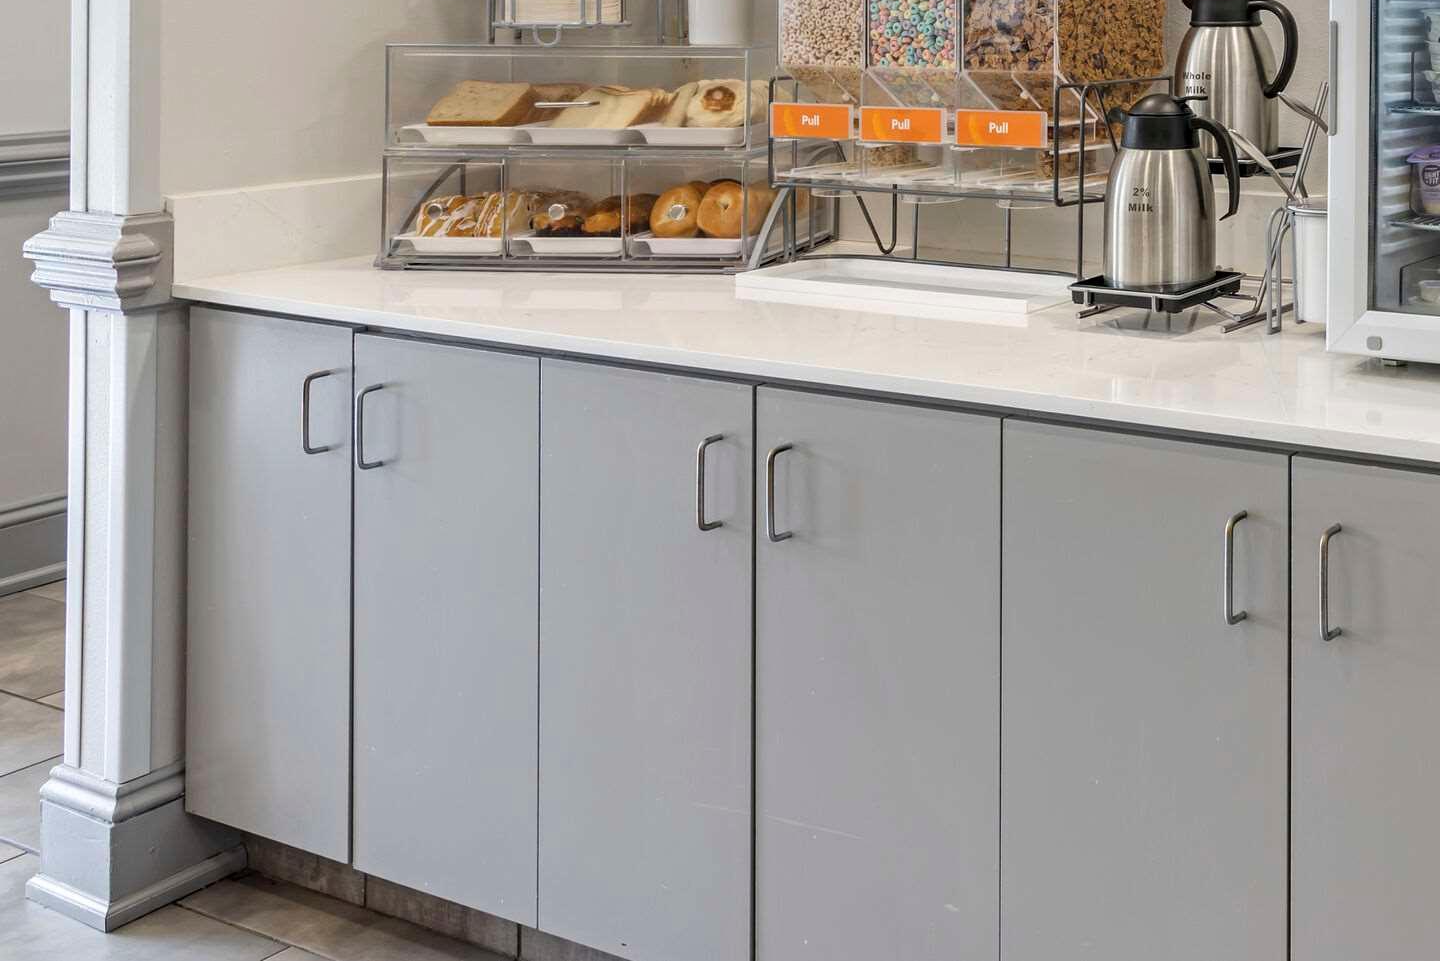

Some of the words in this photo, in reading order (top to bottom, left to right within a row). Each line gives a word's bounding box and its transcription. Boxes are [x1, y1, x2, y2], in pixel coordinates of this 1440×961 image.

[1183, 71, 1212, 81] Whole
[1185, 85, 1207, 94] Milk
[801, 114, 820, 126] Pull
[891, 118, 910, 130] Pull
[988, 121, 1008, 135] Pull
[1132, 187, 1150, 198] 2%
[1128, 202, 1154, 213] Milk
